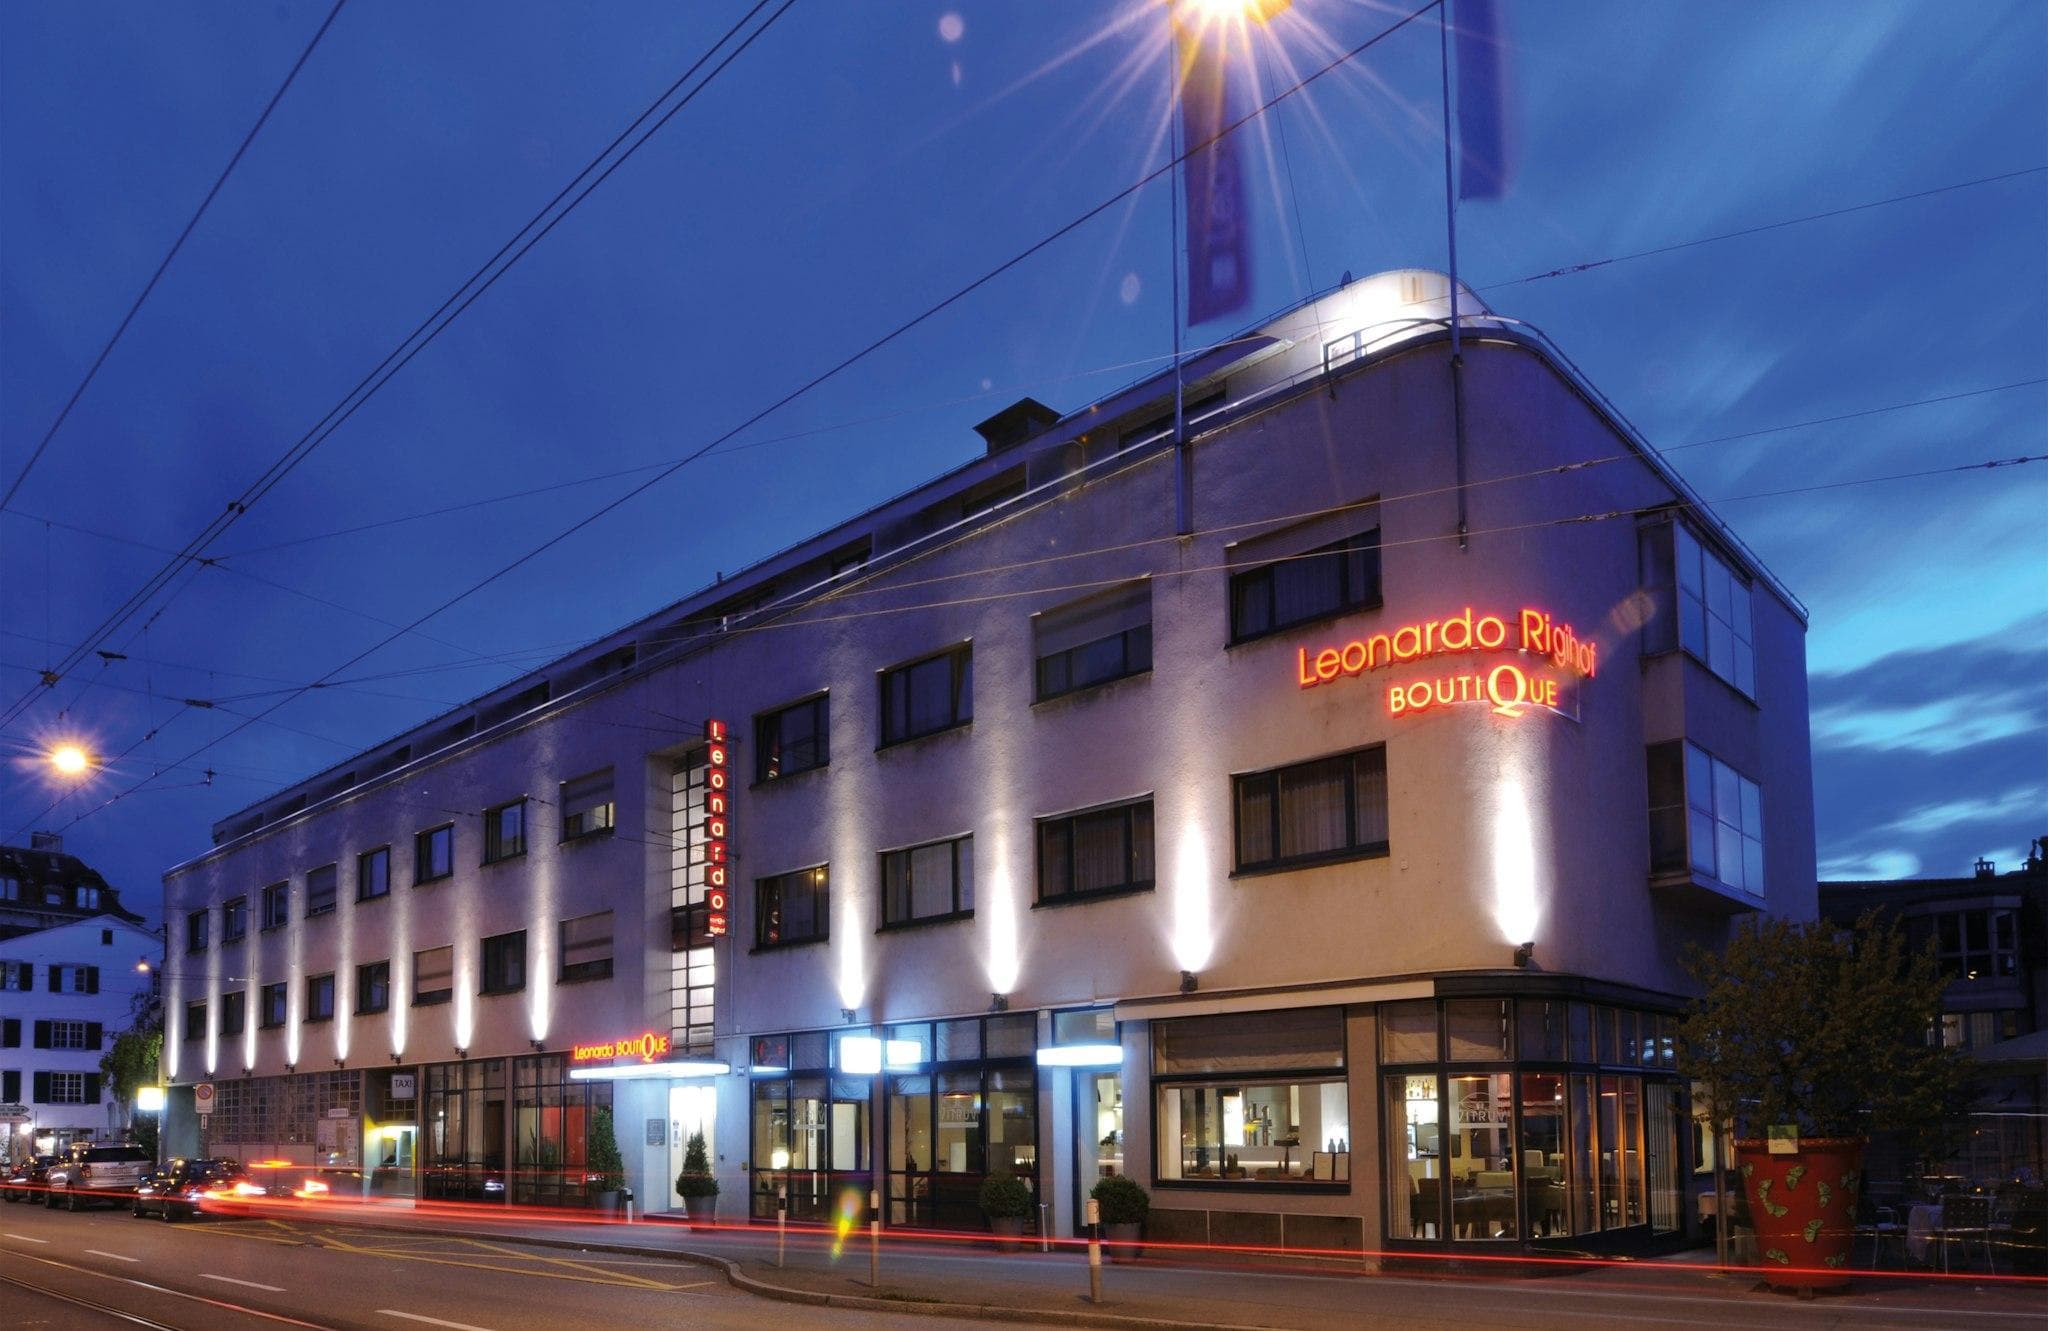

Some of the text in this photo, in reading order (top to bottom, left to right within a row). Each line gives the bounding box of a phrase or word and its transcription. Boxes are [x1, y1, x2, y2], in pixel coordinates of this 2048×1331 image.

[1299, 607, 1597, 687] Leonardo Rigihof
[1390, 664, 1558, 718] BOUTIQUE
[711, 721, 725, 910] Leonardo
[574, 1032, 668, 1063] Leonardo BOUTIQUE
[394, 1079, 413, 1089] TAXI
